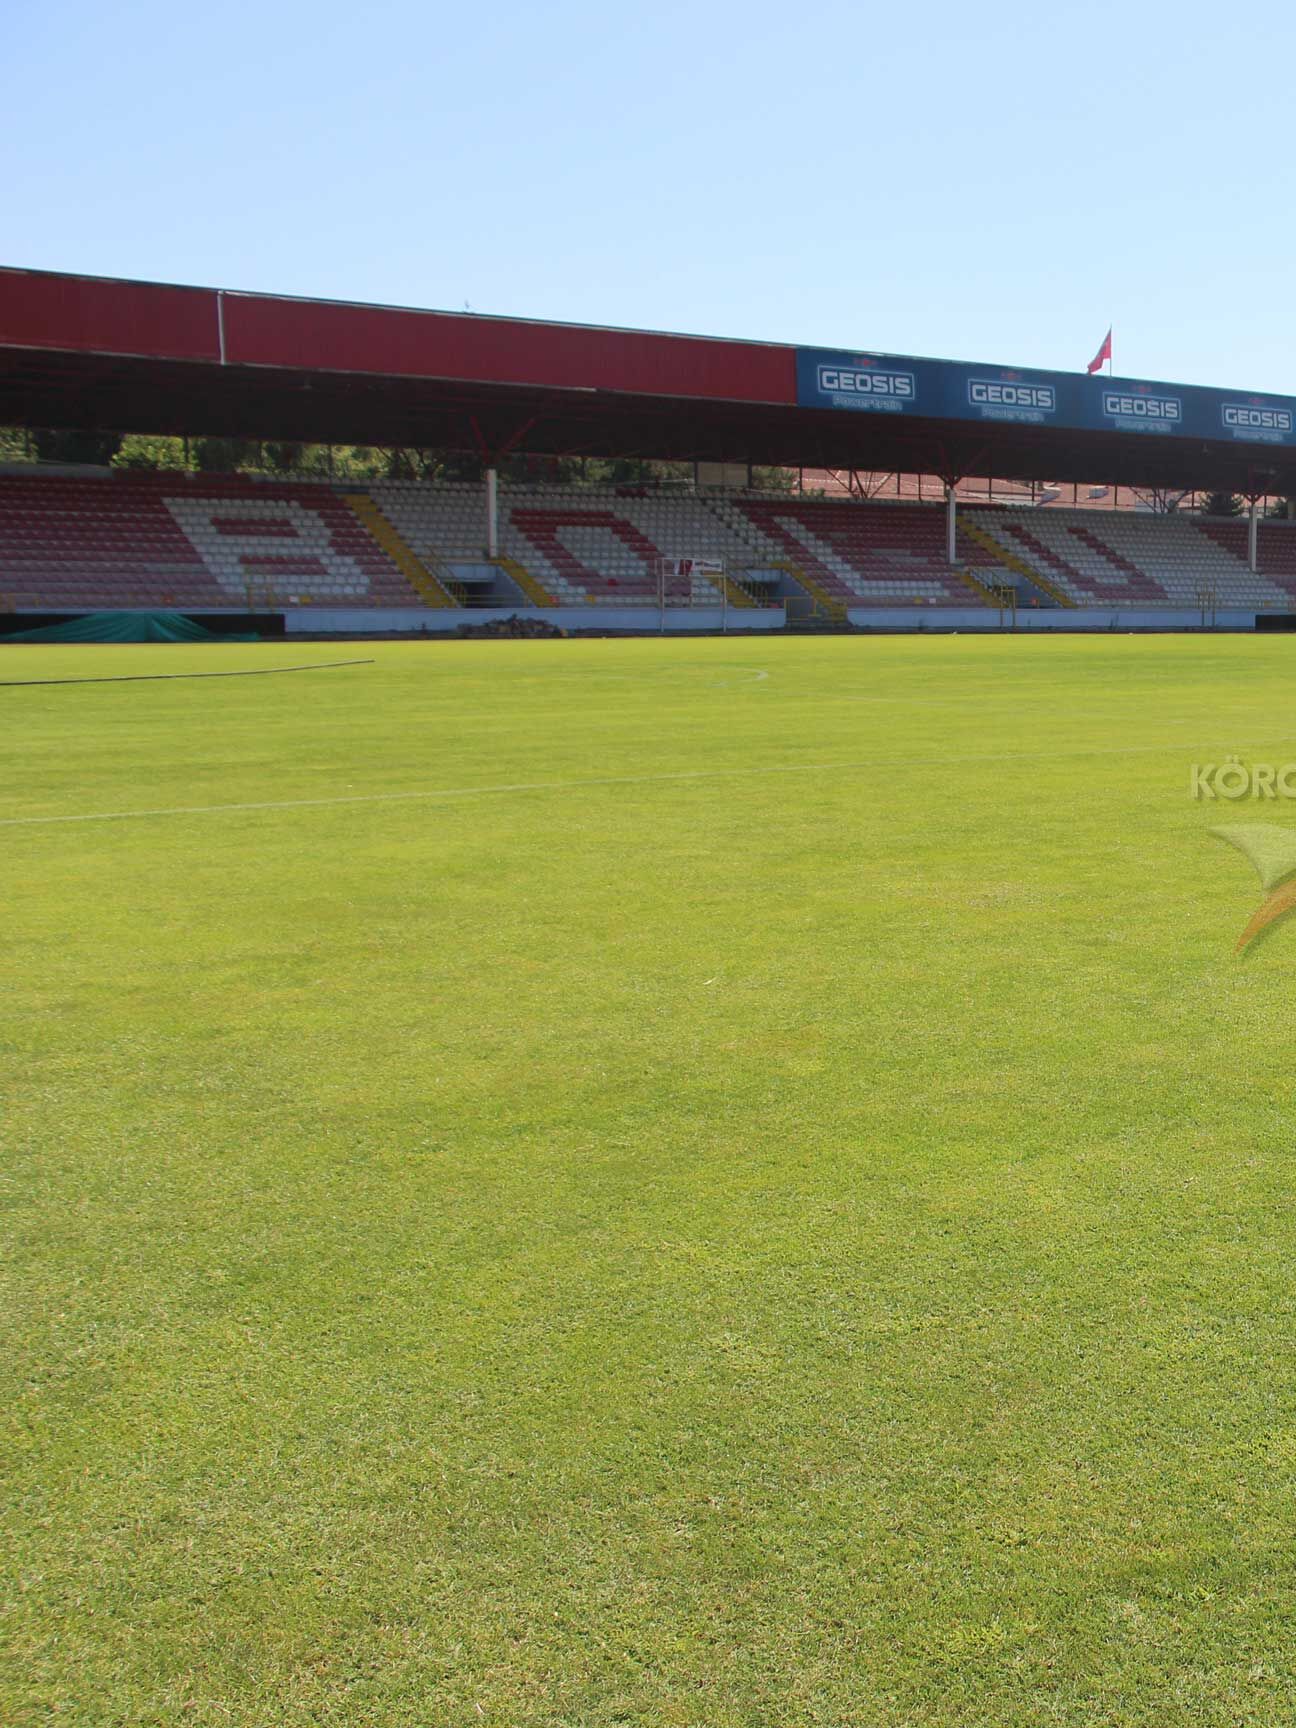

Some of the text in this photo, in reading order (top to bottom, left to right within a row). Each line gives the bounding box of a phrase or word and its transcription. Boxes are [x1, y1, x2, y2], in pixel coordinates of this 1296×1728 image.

[822, 371, 911, 395] GEOSIS
[972, 384, 1052, 407] GEOSIS
[1106, 397, 1178, 418] GEOSIS
[1225, 409, 1290, 428] GEOSIS
